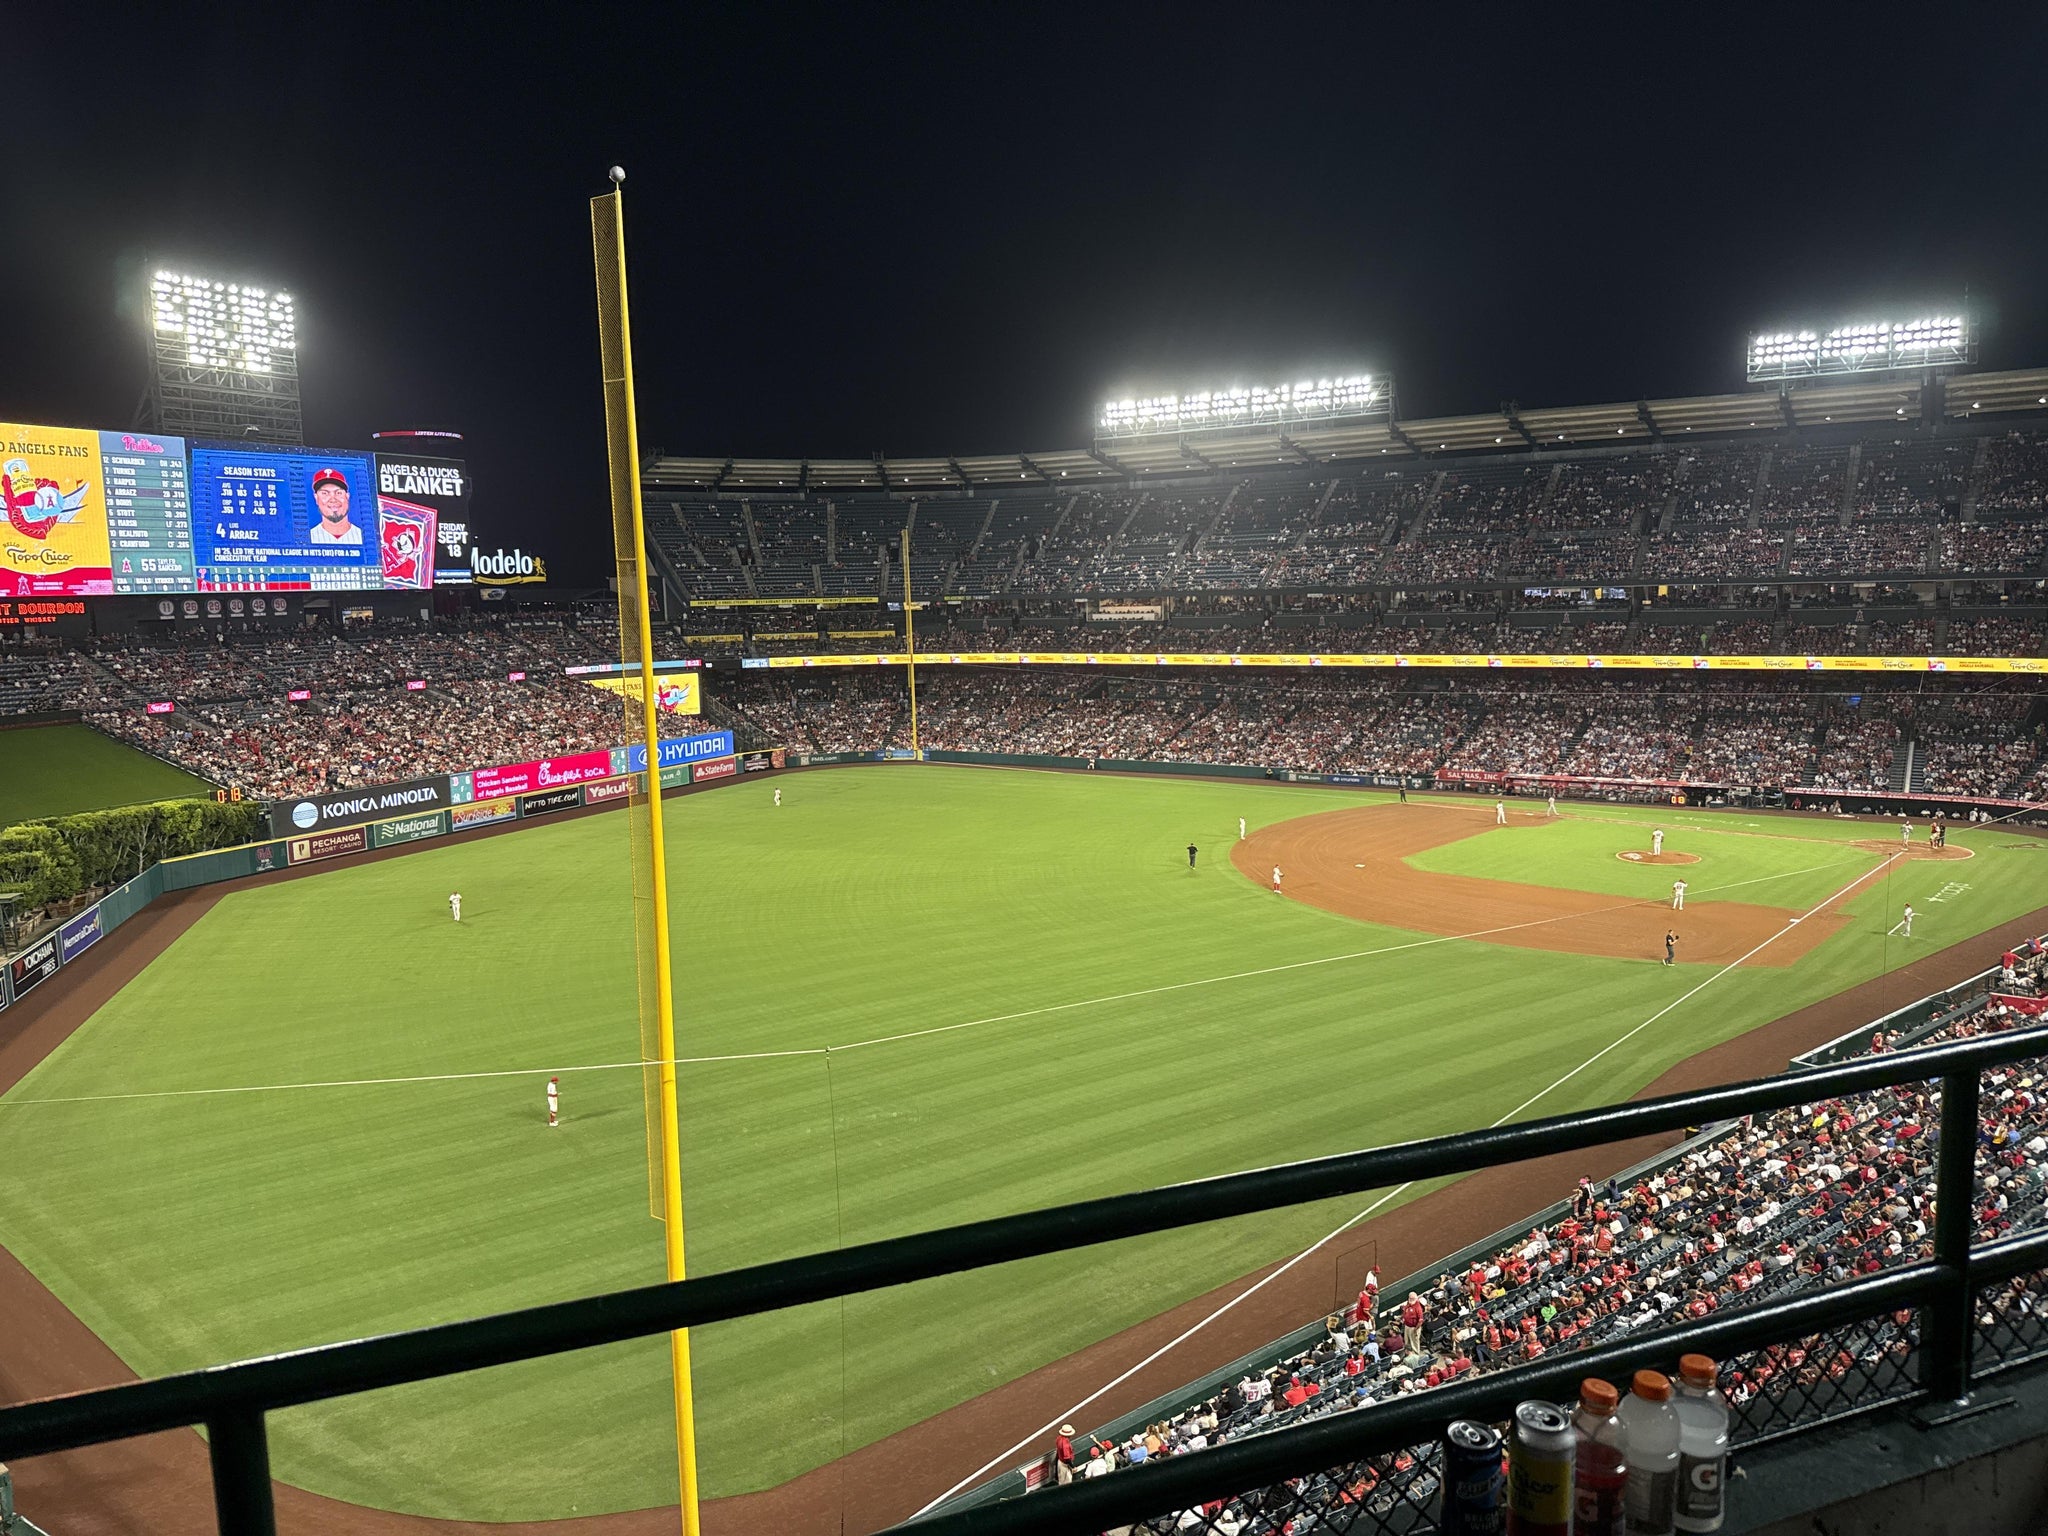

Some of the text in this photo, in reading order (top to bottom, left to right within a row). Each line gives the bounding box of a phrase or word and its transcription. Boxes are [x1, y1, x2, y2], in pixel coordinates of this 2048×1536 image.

[8, 442, 88, 457] ANGELS FANS
[224, 467, 276, 477] SEASON STATS
[380, 464, 459, 478] ANGELS & DUCKS
[380, 474, 464, 496] BLANKET
[216, 523, 226, 538] 4
[230, 530, 259, 539] ARRAEZ
[439, 523, 465, 531] FRIDAY
[438, 531, 468, 544] SEPT
[7, 548, 73, 565] Topo Chico
[447, 545, 462, 557] 18
[141, 558, 156, 571] 55
[18, 602, 85, 614] BOURBON
[666, 737, 725, 760] HYUNDAI
[477, 770, 498, 778] Official
[477, 774, 528, 788] Chicken Sandwich
[505, 783, 528, 793] Baseball
[589, 781, 634, 797] Yakult
[322, 787, 438, 819] KONICA MINOLTA
[525, 792, 577, 810] NITTO TIRE.COM
[456, 809, 492, 824] Surfside
[394, 815, 439, 835] National
[312, 833, 360, 848] PECHANGA
[313, 841, 362, 854] RESORT CASINO
[64, 924, 95, 950] MemorialCare
[24, 942, 54, 970] YOKOHAMA
[42, 960, 56, 976] TIRES
[1248, 1392, 1259, 1400] 27
[1691, 1463, 1717, 1491] G
